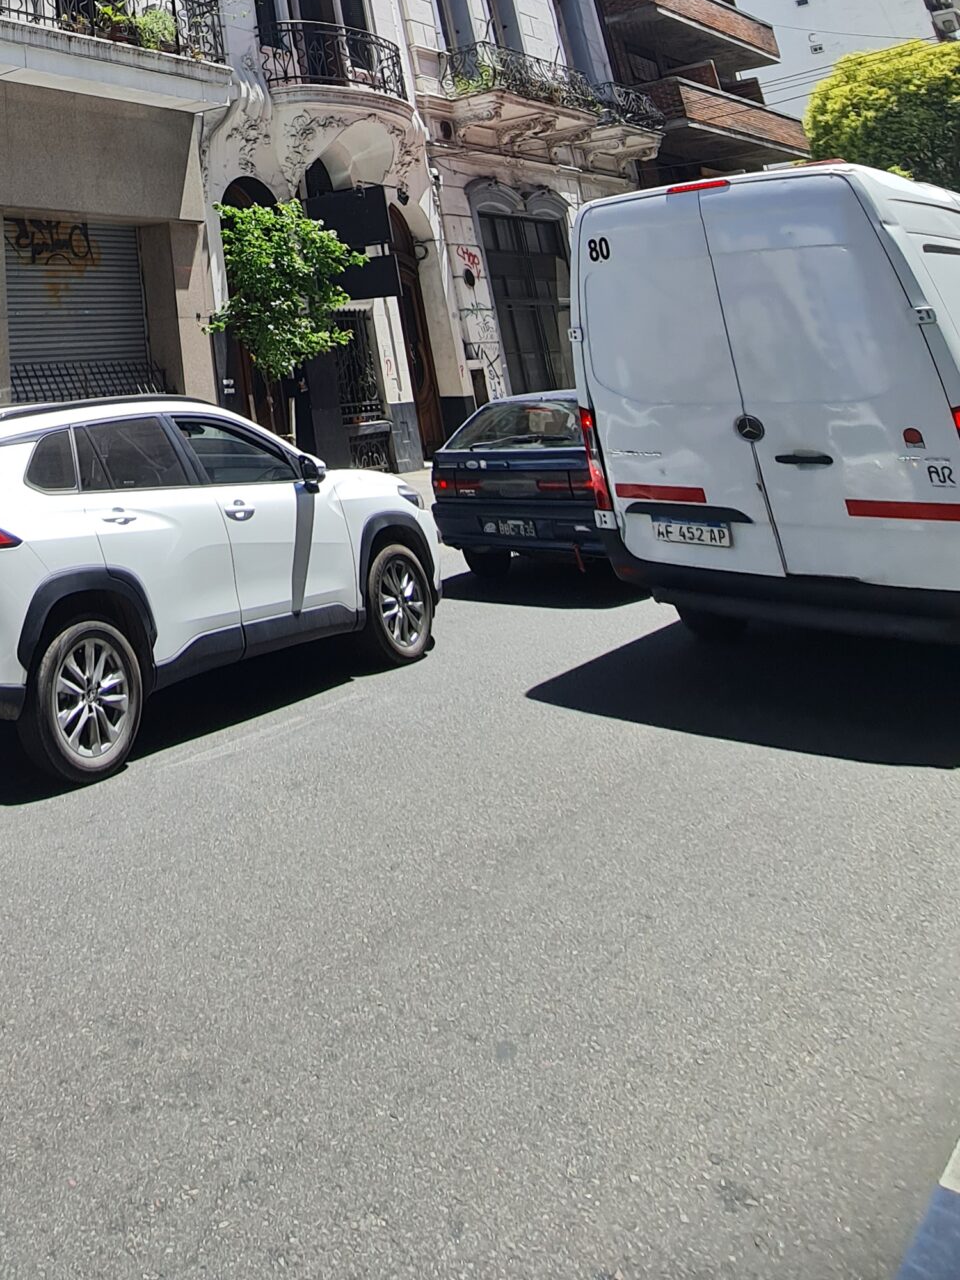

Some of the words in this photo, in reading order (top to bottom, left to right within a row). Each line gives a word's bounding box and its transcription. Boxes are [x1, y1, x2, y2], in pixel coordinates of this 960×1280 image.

[588, 236, 611, 262] 80
[657, 524, 674, 539] AF
[679, 526, 706, 542] 452
[709, 528, 726, 544] AP
